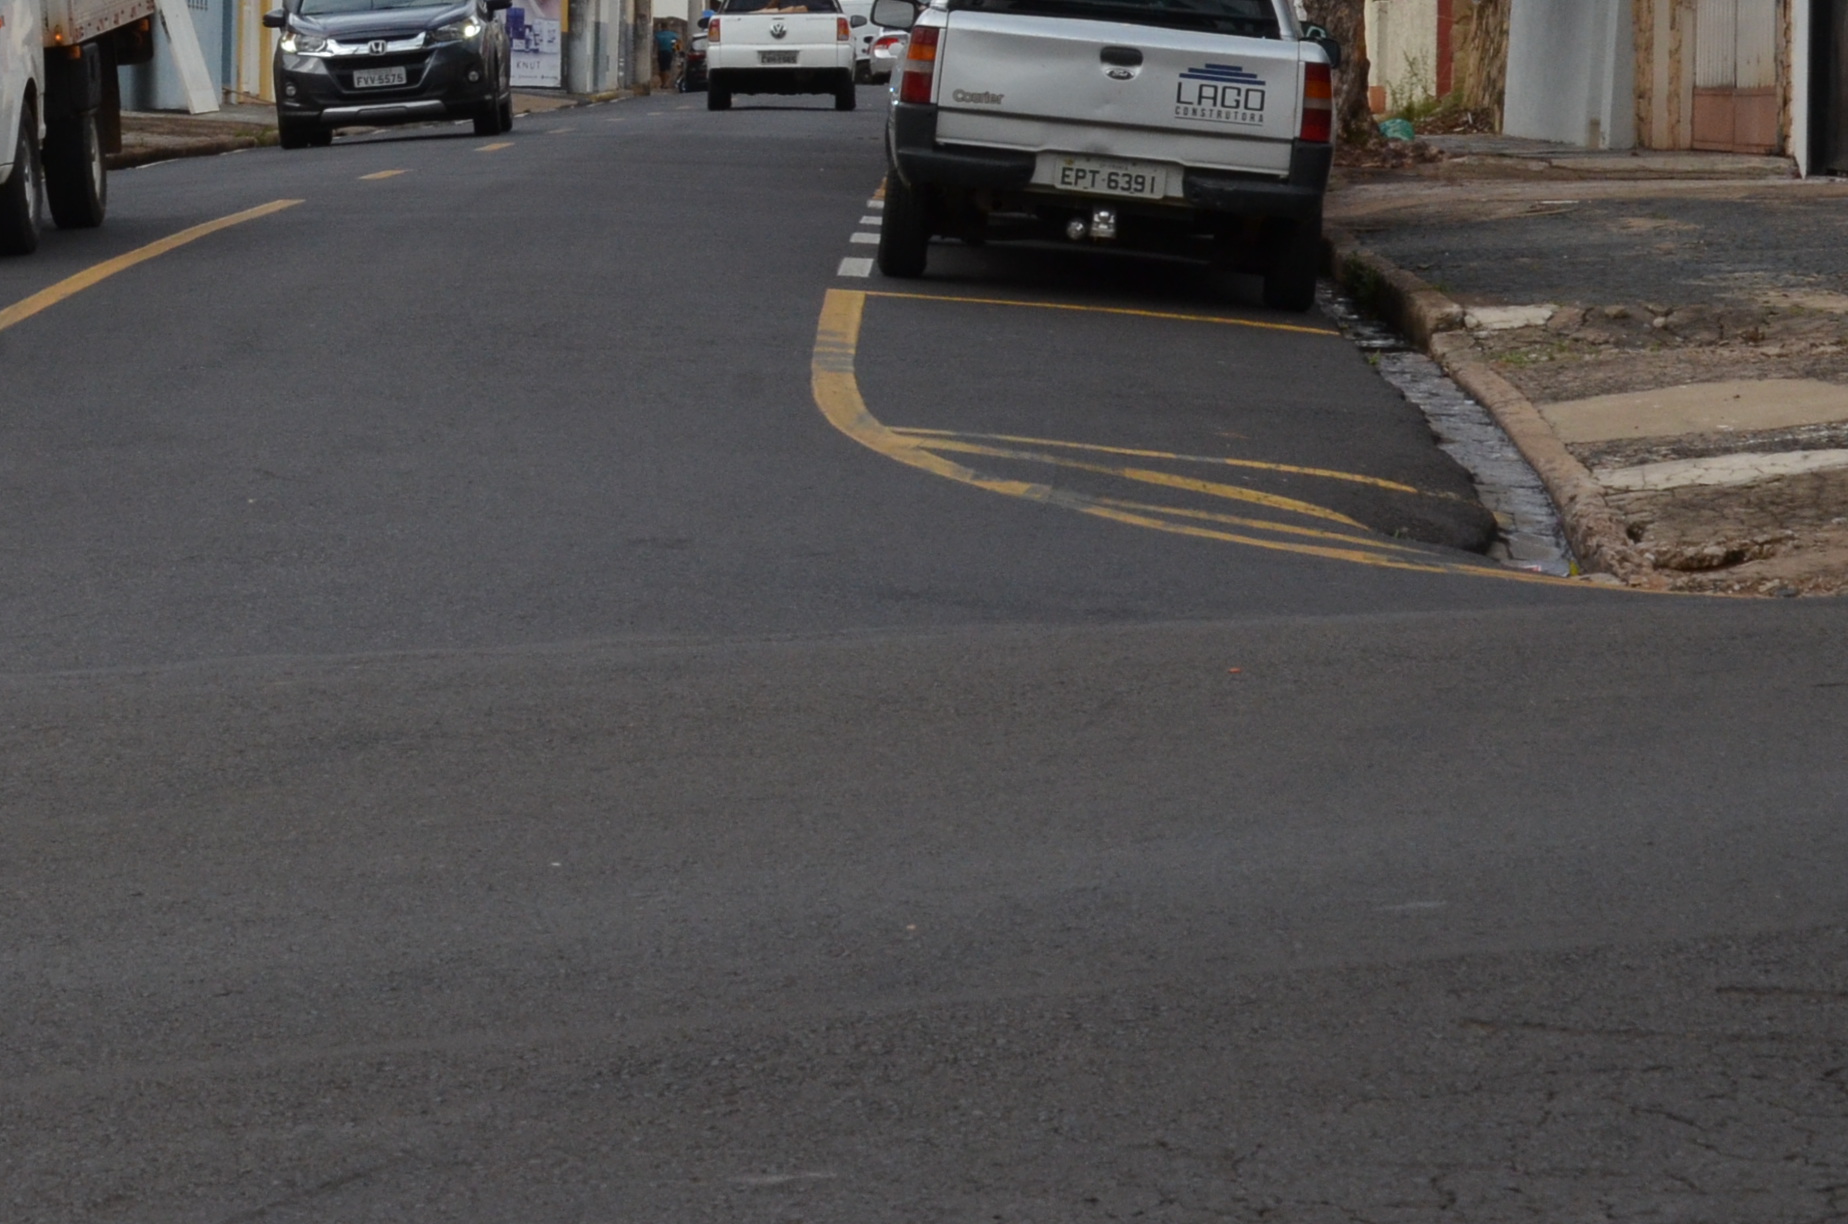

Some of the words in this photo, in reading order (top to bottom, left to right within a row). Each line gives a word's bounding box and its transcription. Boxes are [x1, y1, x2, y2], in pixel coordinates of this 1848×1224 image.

[516, 60, 541, 70] KNUT
[952, 88, 1005, 105] Courier
[1176, 81, 1266, 112] LAGO
[1174, 105, 1264, 123] CONSTRUTORA
